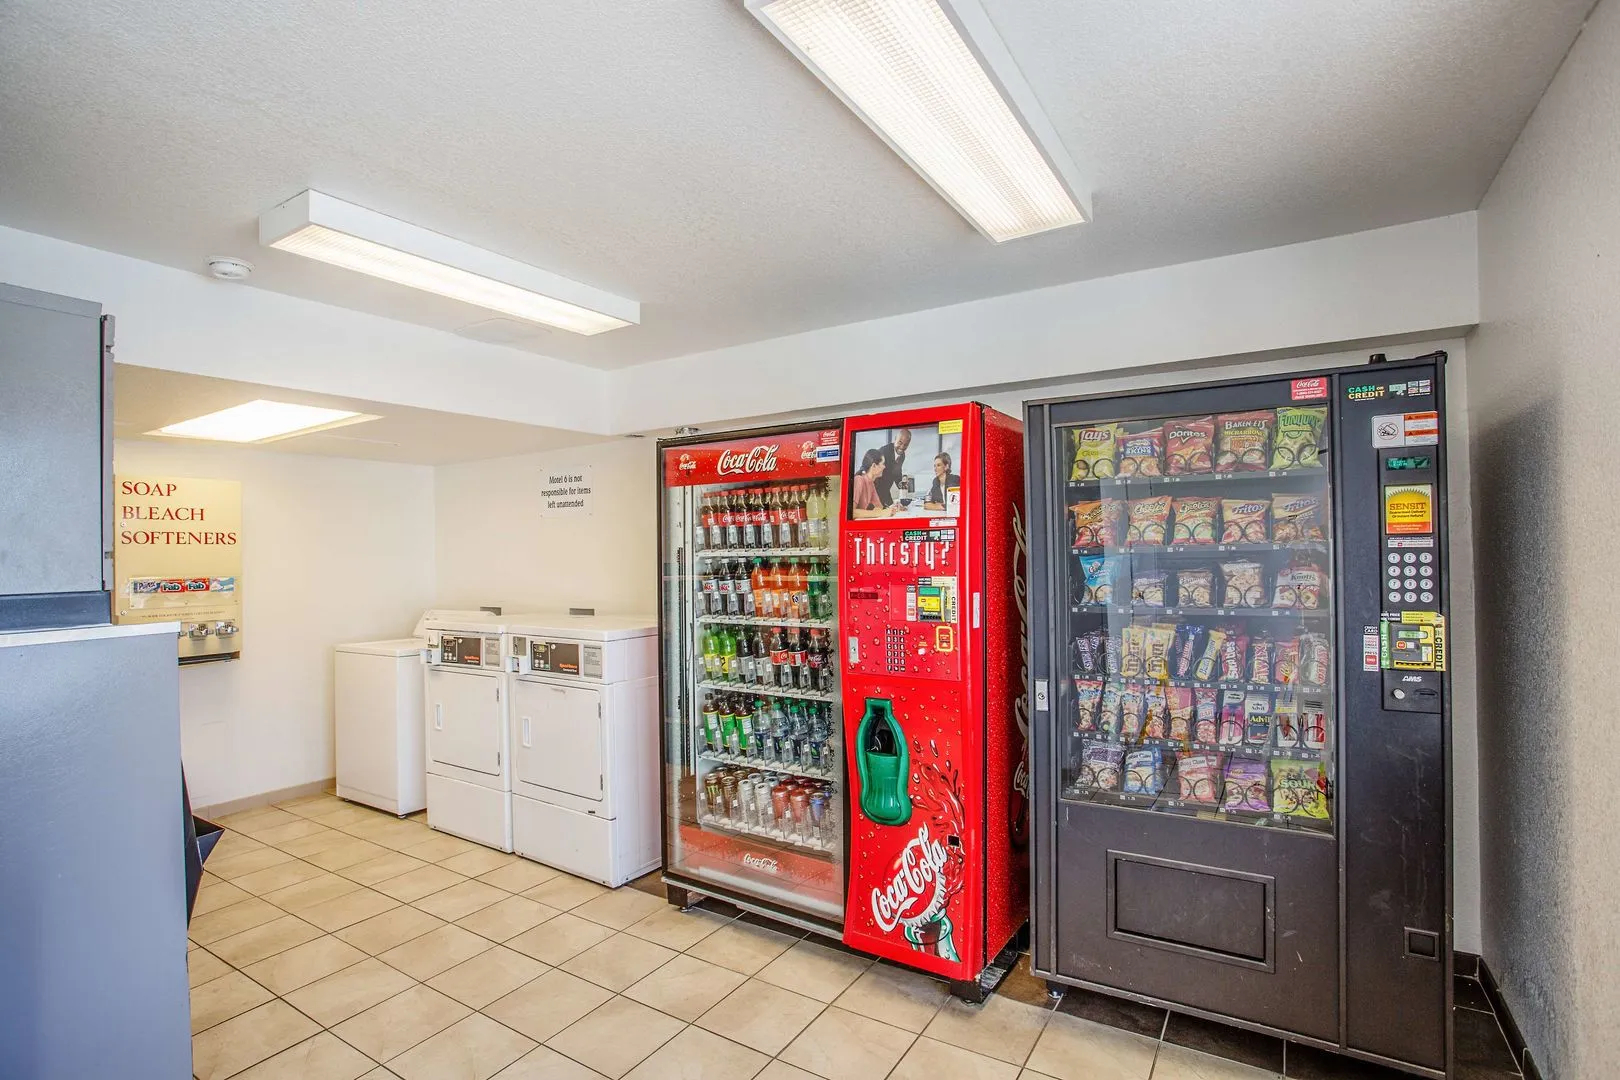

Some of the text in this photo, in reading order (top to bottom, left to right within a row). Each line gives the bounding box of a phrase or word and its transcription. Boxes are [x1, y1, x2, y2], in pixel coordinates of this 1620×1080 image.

[1348, 390, 1385, 399] CREDIT
[717, 443, 781, 476] Coca-Cola
[549, 475, 563, 484] Motel
[564, 475, 568, 483] 6
[121, 480, 177, 497] SOAP
[541, 488, 568, 498] responsible
[569, 487, 577, 495] for
[547, 499, 584, 508] left unattended
[1232, 503, 1263, 514] Fritos
[1389, 502, 1426, 510] SENSIT
[122, 505, 205, 521] BLEACH
[121, 530, 237, 545] SOFTENERS
[854, 536, 950, 570] Thirsty?
[188, 582, 205, 590] Fab
[1435, 637, 1443, 669] CREDIT
[1250, 715, 1271, 723] Advil
[1280, 779, 1317, 791] SOUR
[743, 853, 778, 873] Coca-Cola
[871, 821, 949, 933] Coca-Cola
